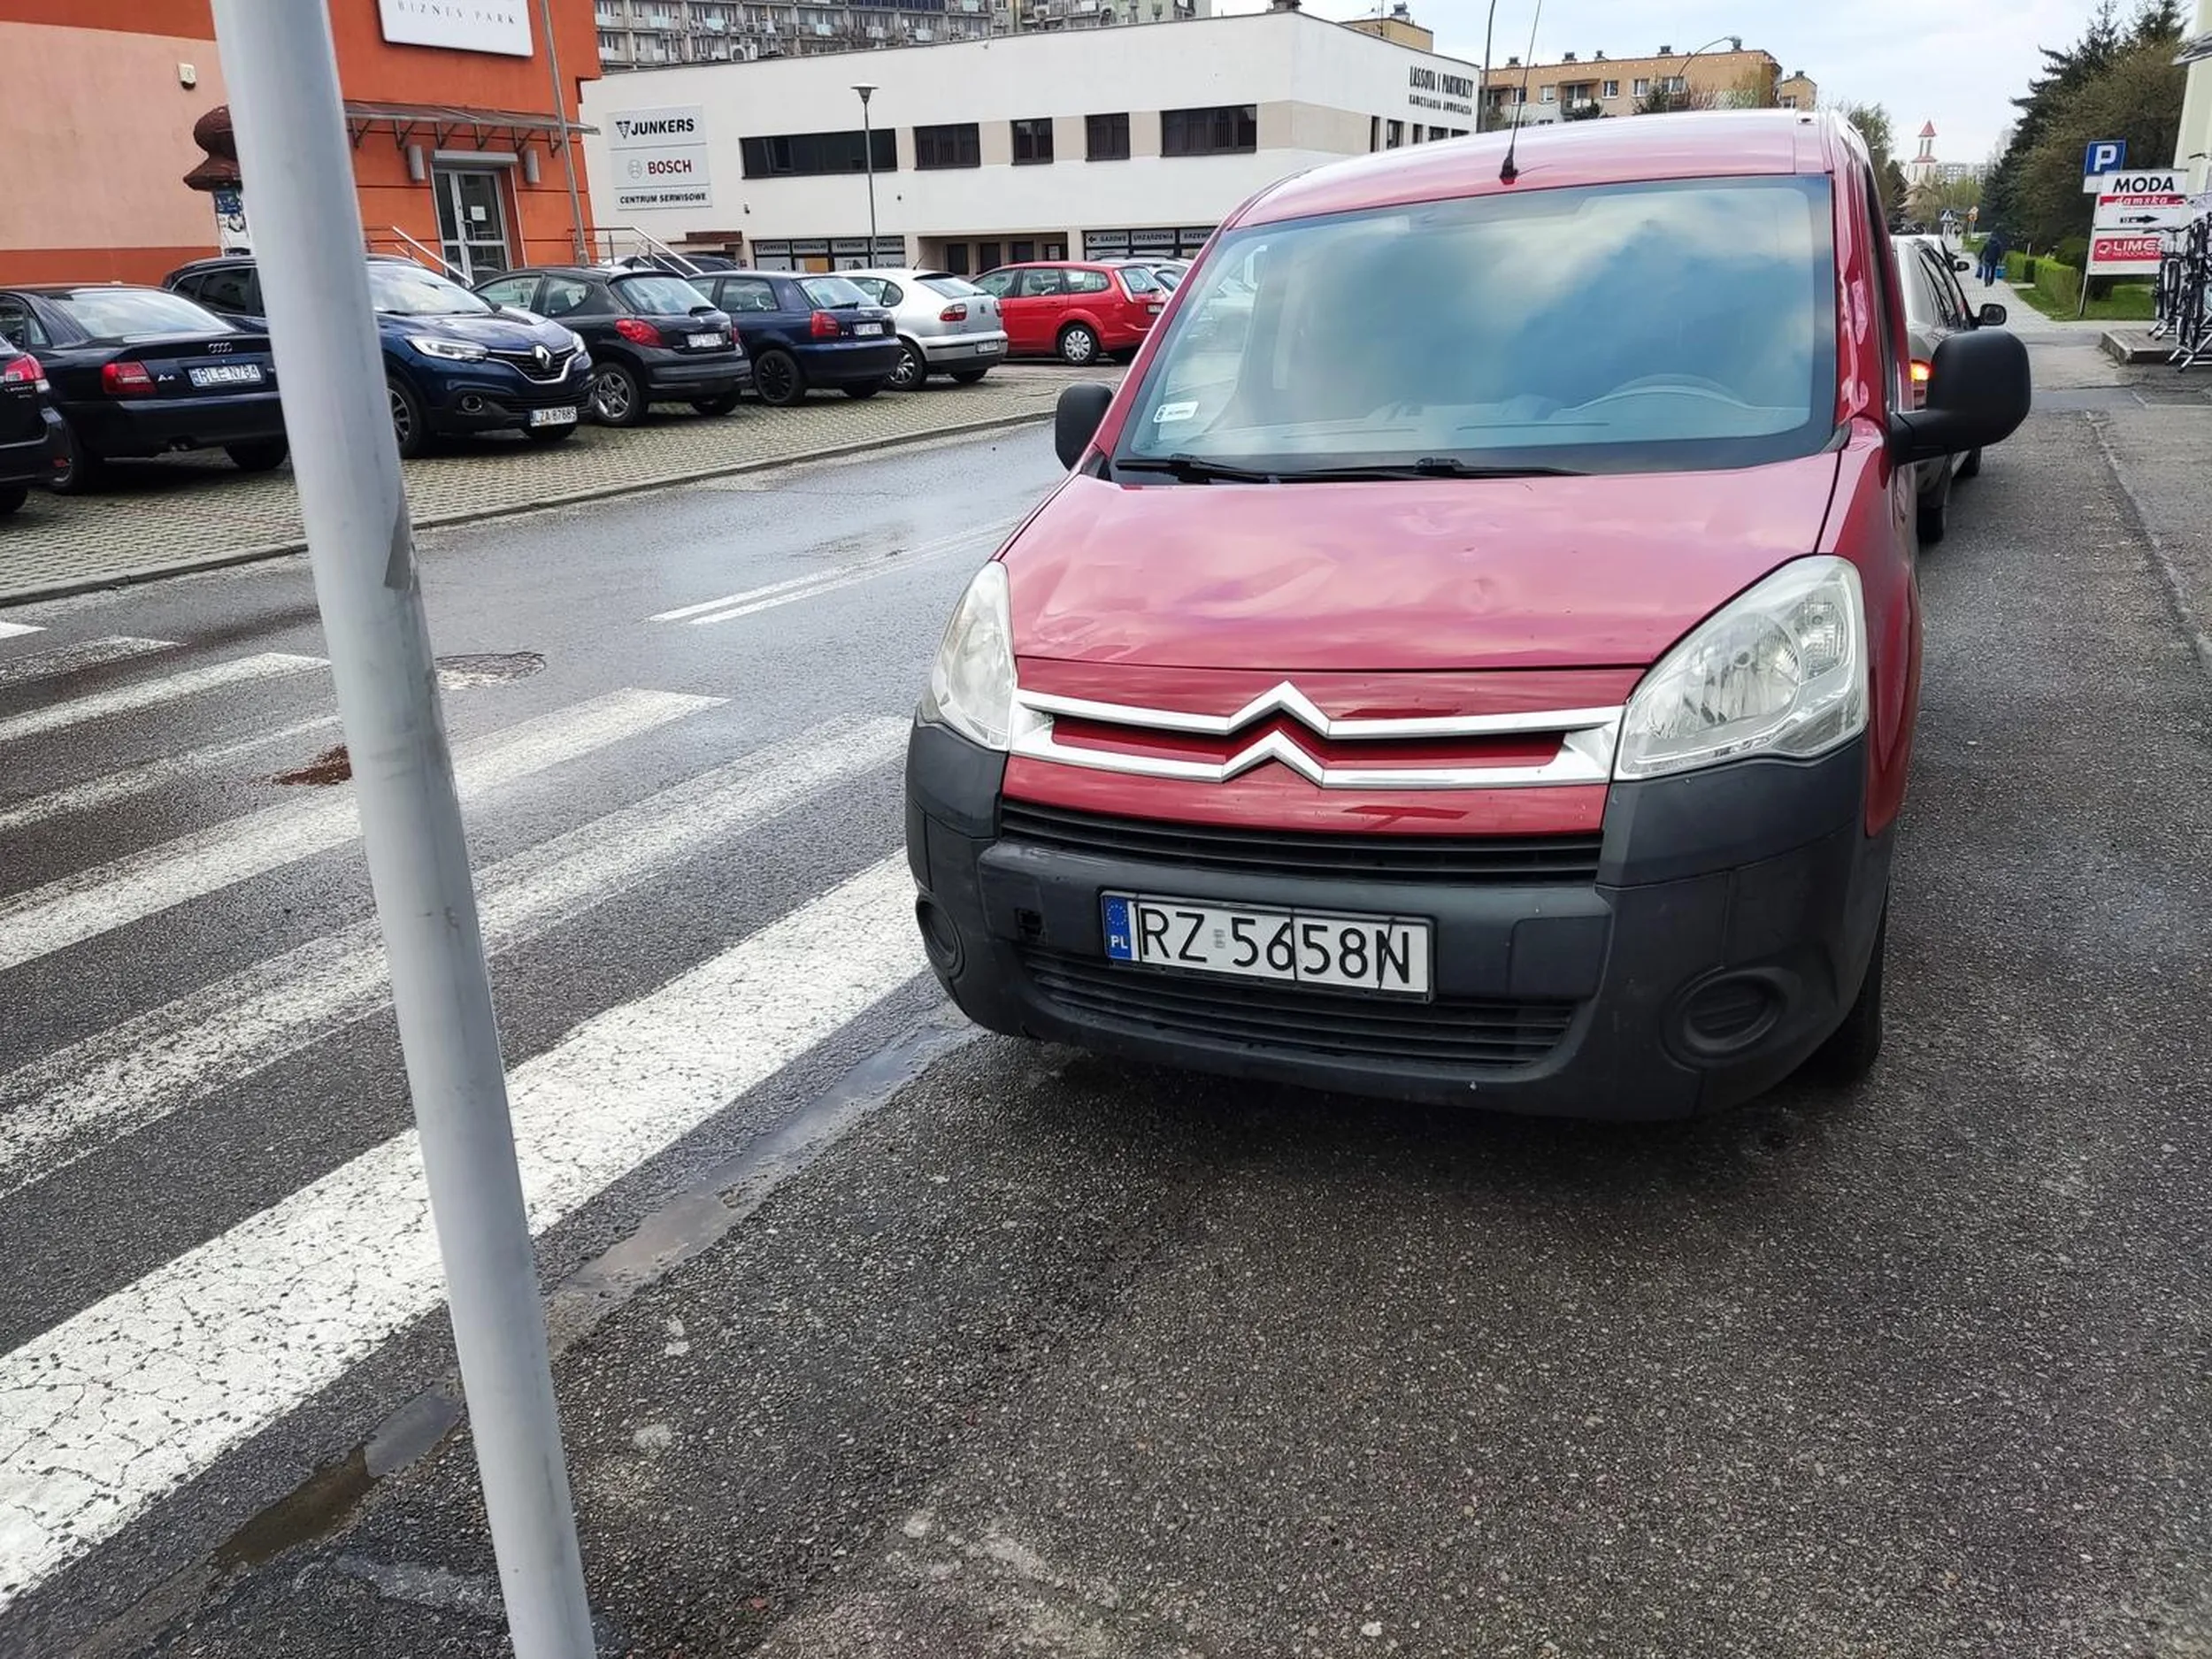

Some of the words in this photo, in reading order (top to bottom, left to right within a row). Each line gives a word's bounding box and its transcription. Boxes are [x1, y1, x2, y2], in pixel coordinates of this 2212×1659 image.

[397, 2, 463, 18] BIZNES
[474, 11, 515, 25] PARK
[631, 119, 695, 135] JUNKERS
[2093, 144, 2117, 172] P
[648, 159, 692, 174] BOSCH
[2113, 176, 2175, 193] MODA
[619, 195, 657, 204] CENTRUM
[659, 193, 707, 203] SERWISOWE
[2116, 195, 2168, 205] damska
[1110, 935, 1128, 949] PL
[1139, 908, 1207, 963] RZ
[1231, 917, 1409, 985] 5658N
